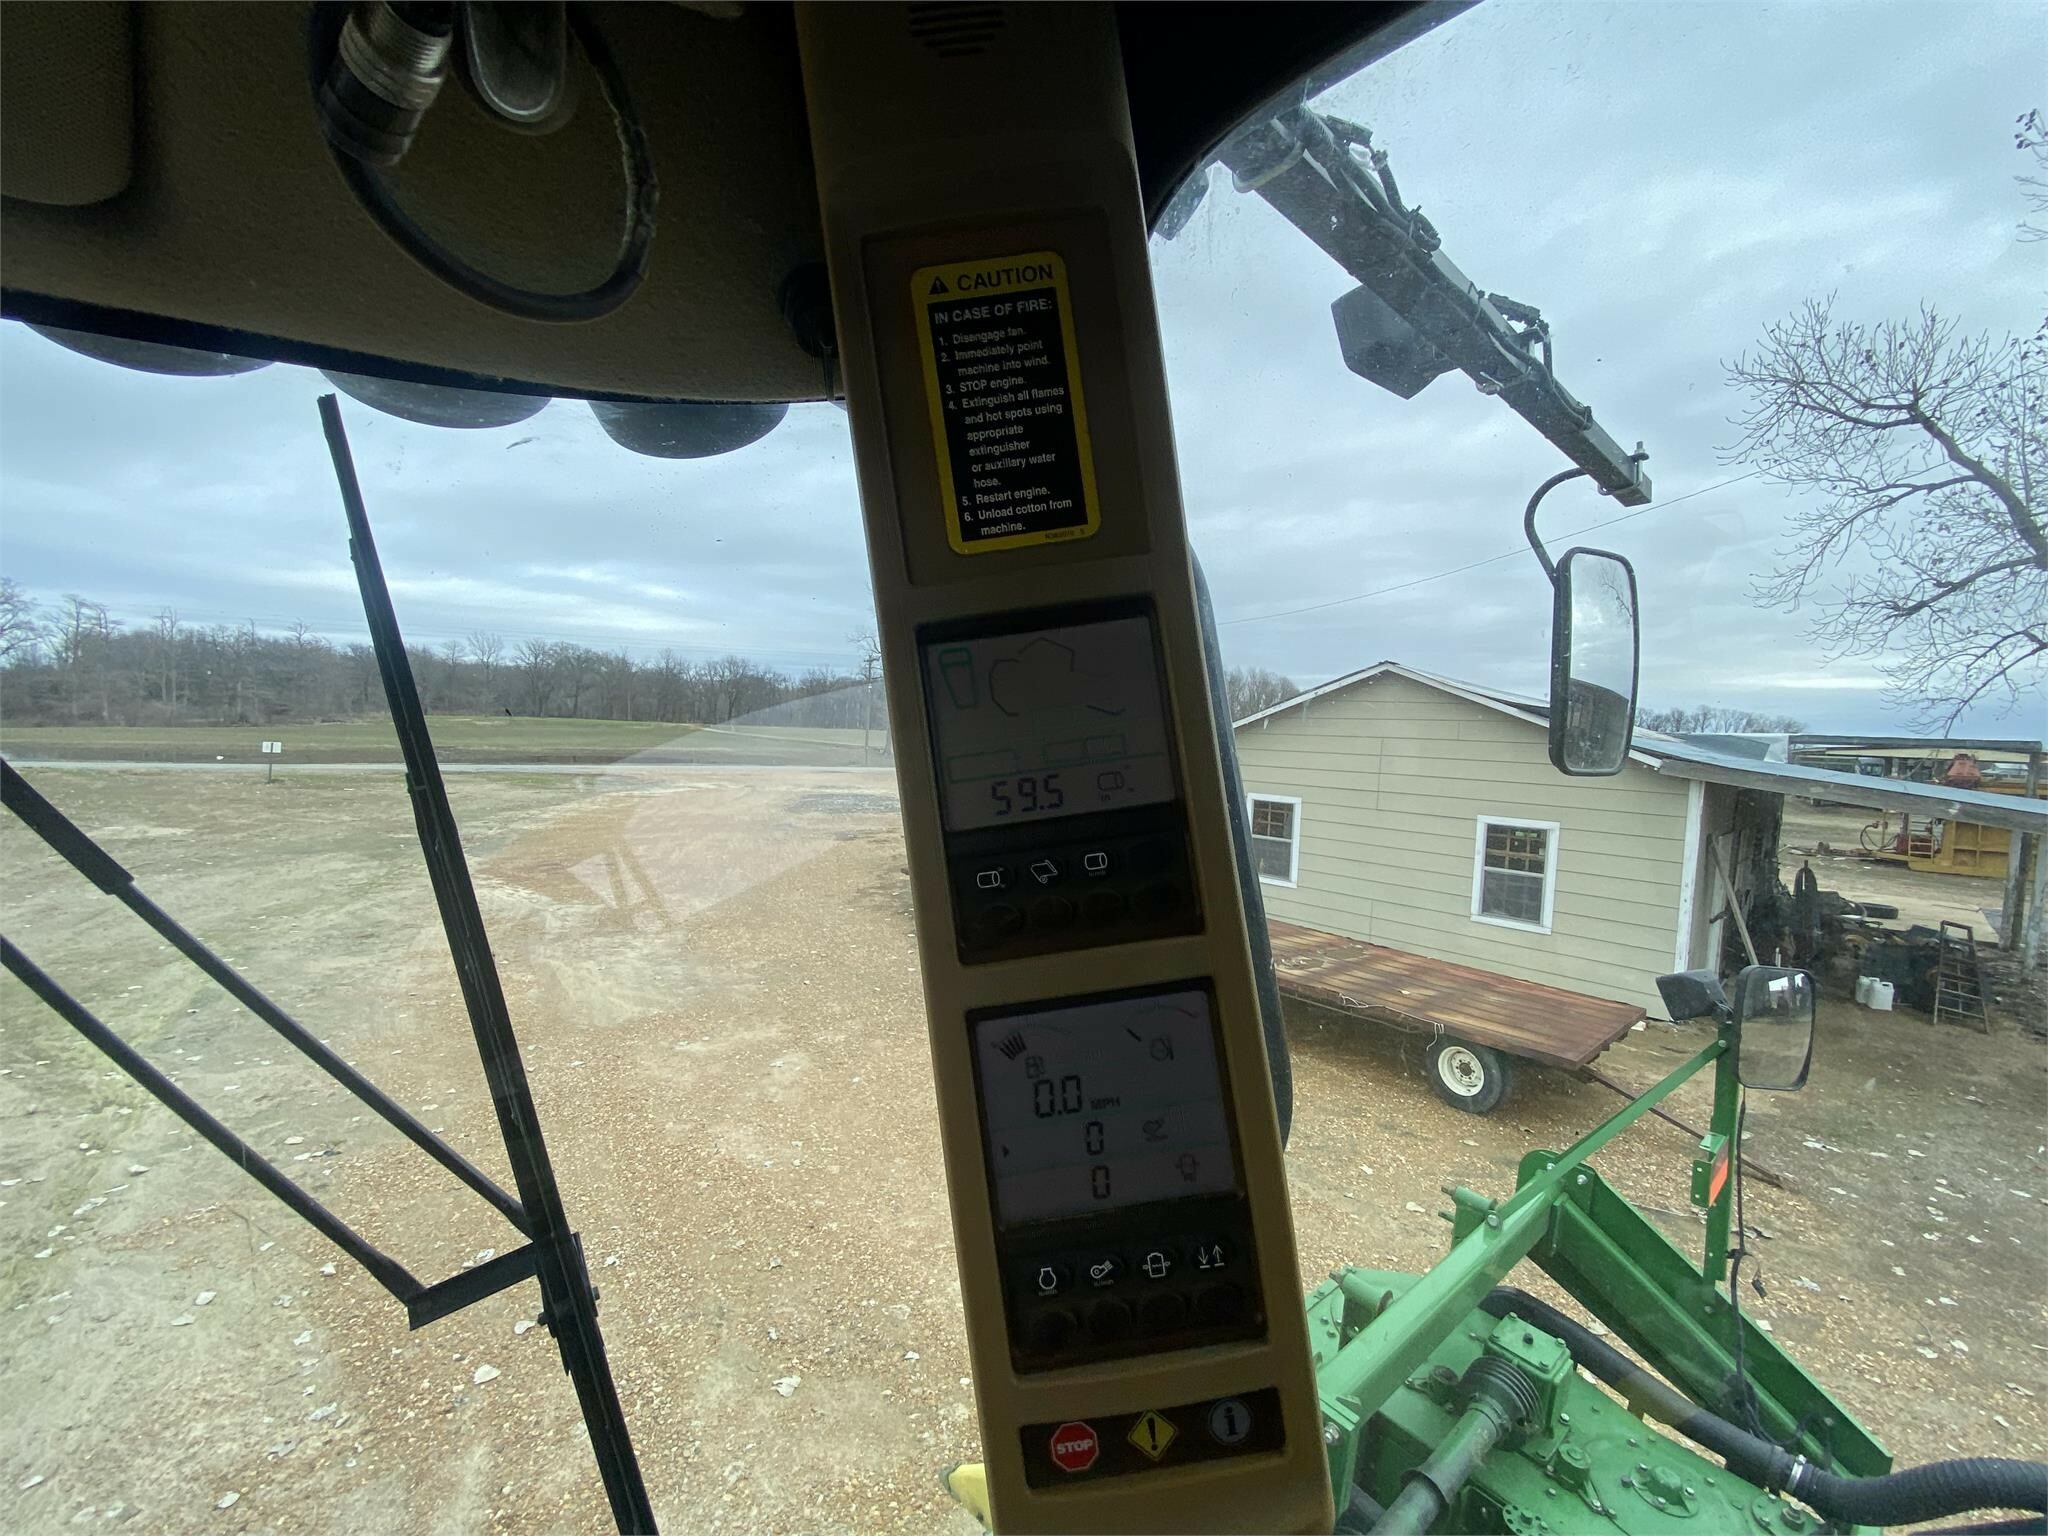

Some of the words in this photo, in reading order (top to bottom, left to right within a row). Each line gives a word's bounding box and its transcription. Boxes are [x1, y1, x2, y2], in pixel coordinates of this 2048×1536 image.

[957, 263, 1054, 291] CAUTION
[935, 312, 948, 324] IN
[952, 306, 990, 322] CASE
[994, 303, 1013, 316] OF
[1017, 298, 1053, 313] FIRE:
[939, 336, 948, 346] 1.
[953, 330, 1005, 345] Disengage
[1007, 326, 1027, 337] fan.
[941, 352, 951, 363] 2.
[955, 344, 1015, 361] Immediately
[1017, 339, 1043, 352] point
[957, 363, 1000, 376] machine
[1002, 359, 1022, 370] into
[1024, 355, 1050, 367] wind.
[945, 384, 955, 394] 3.
[959, 379, 987, 393] STOP
[990, 375, 1027, 389] engine.
[948, 400, 957, 410] 4.
[962, 392, 1015, 409] Extinguish
[1017, 390, 1029, 401] all
[1031, 386, 1064, 399] flames
[964, 413, 984, 425] and
[986, 410, 1003, 422] hot
[1004, 407, 1033, 421] spots
[1035, 402, 1063, 416] using
[967, 425, 1024, 442] appropriate
[968, 441, 1030, 457] extinguisher
[971, 463, 982, 473] or
[985, 457, 1026, 471] auxiliary
[1029, 452, 1056, 464] water
[973, 476, 1001, 488] hose.
[962, 496, 972, 506] 5.
[976, 490, 1012, 504] Restart
[1014, 485, 1051, 500] engine.
[964, 511, 973, 522] 6.
[978, 506, 1013, 520] Unload
[1015, 501, 1047, 515] cotton
[1049, 498, 1072, 509] from
[981, 522, 1026, 536] machine.
[991, 773, 1064, 815] 59.5
[1034, 1074, 1083, 1119] 0.0
[1086, 1120, 1104, 1156] 0
[1092, 1165, 1110, 1199] 0
[1056, 1438, 1094, 1455] STOP
